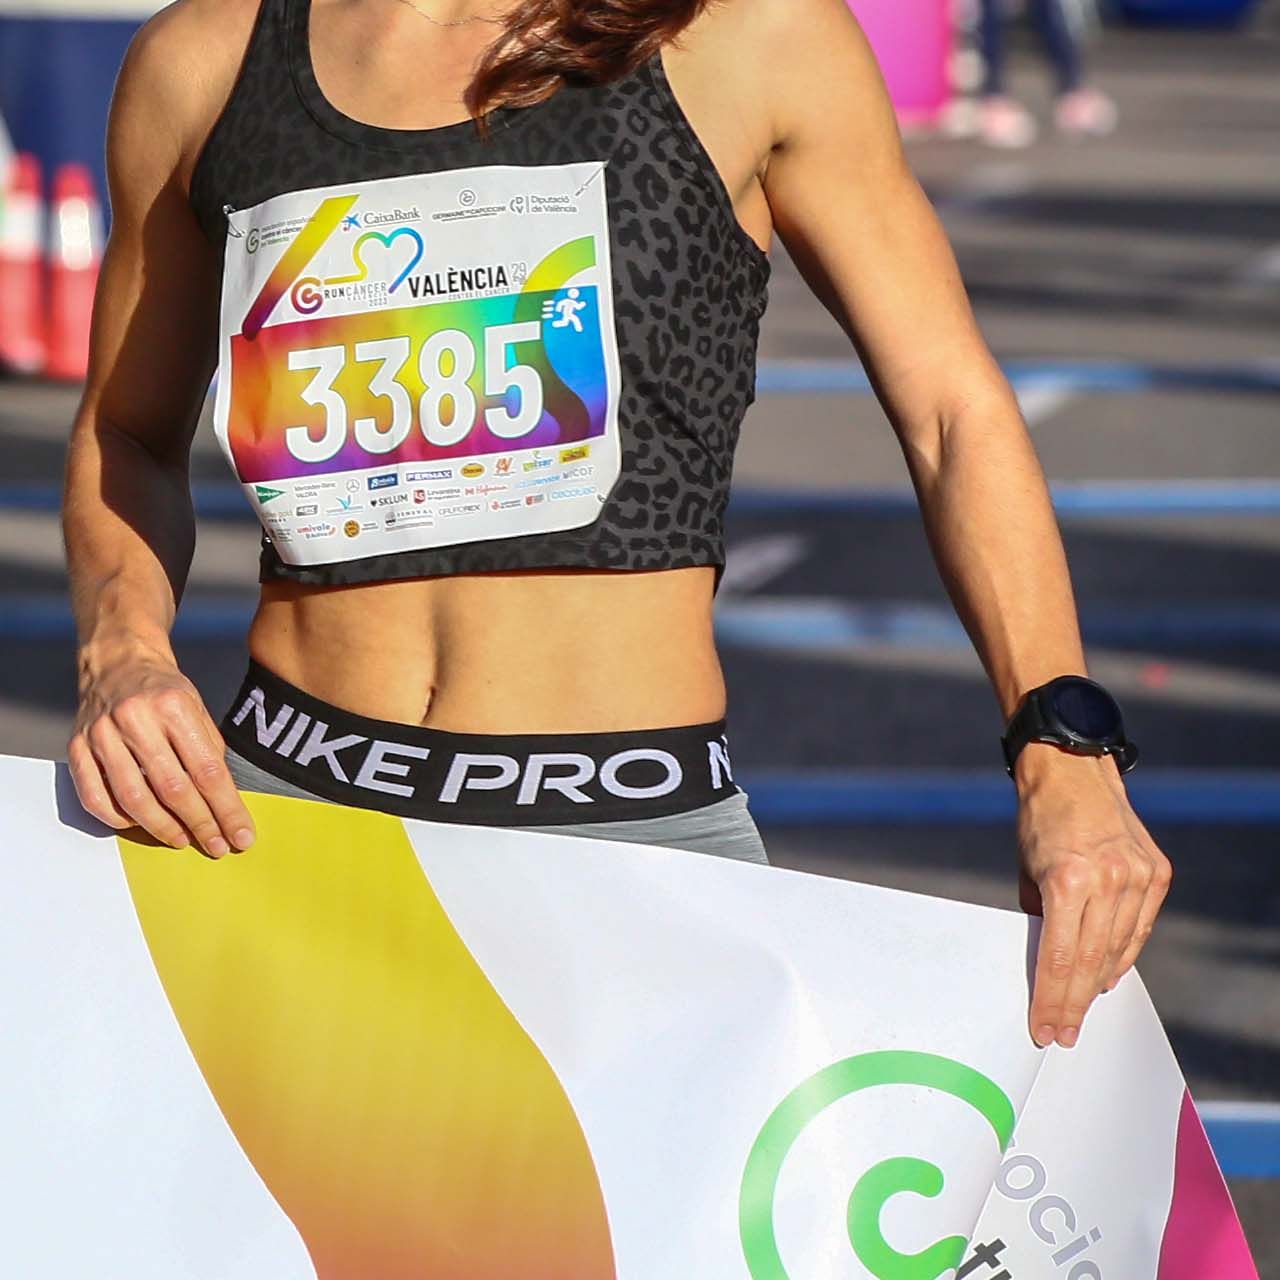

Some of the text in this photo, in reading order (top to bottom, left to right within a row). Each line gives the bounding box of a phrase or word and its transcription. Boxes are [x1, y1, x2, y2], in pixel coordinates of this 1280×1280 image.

[364, 207, 421, 225] CaixaBank
[408, 266, 508, 298] VALÈNCIA
[286, 320, 543, 463] 3385
[379, 493, 408, 506] SKLUM
[233, 686, 431, 798] NIKE
[439, 748, 683, 806] PRO
